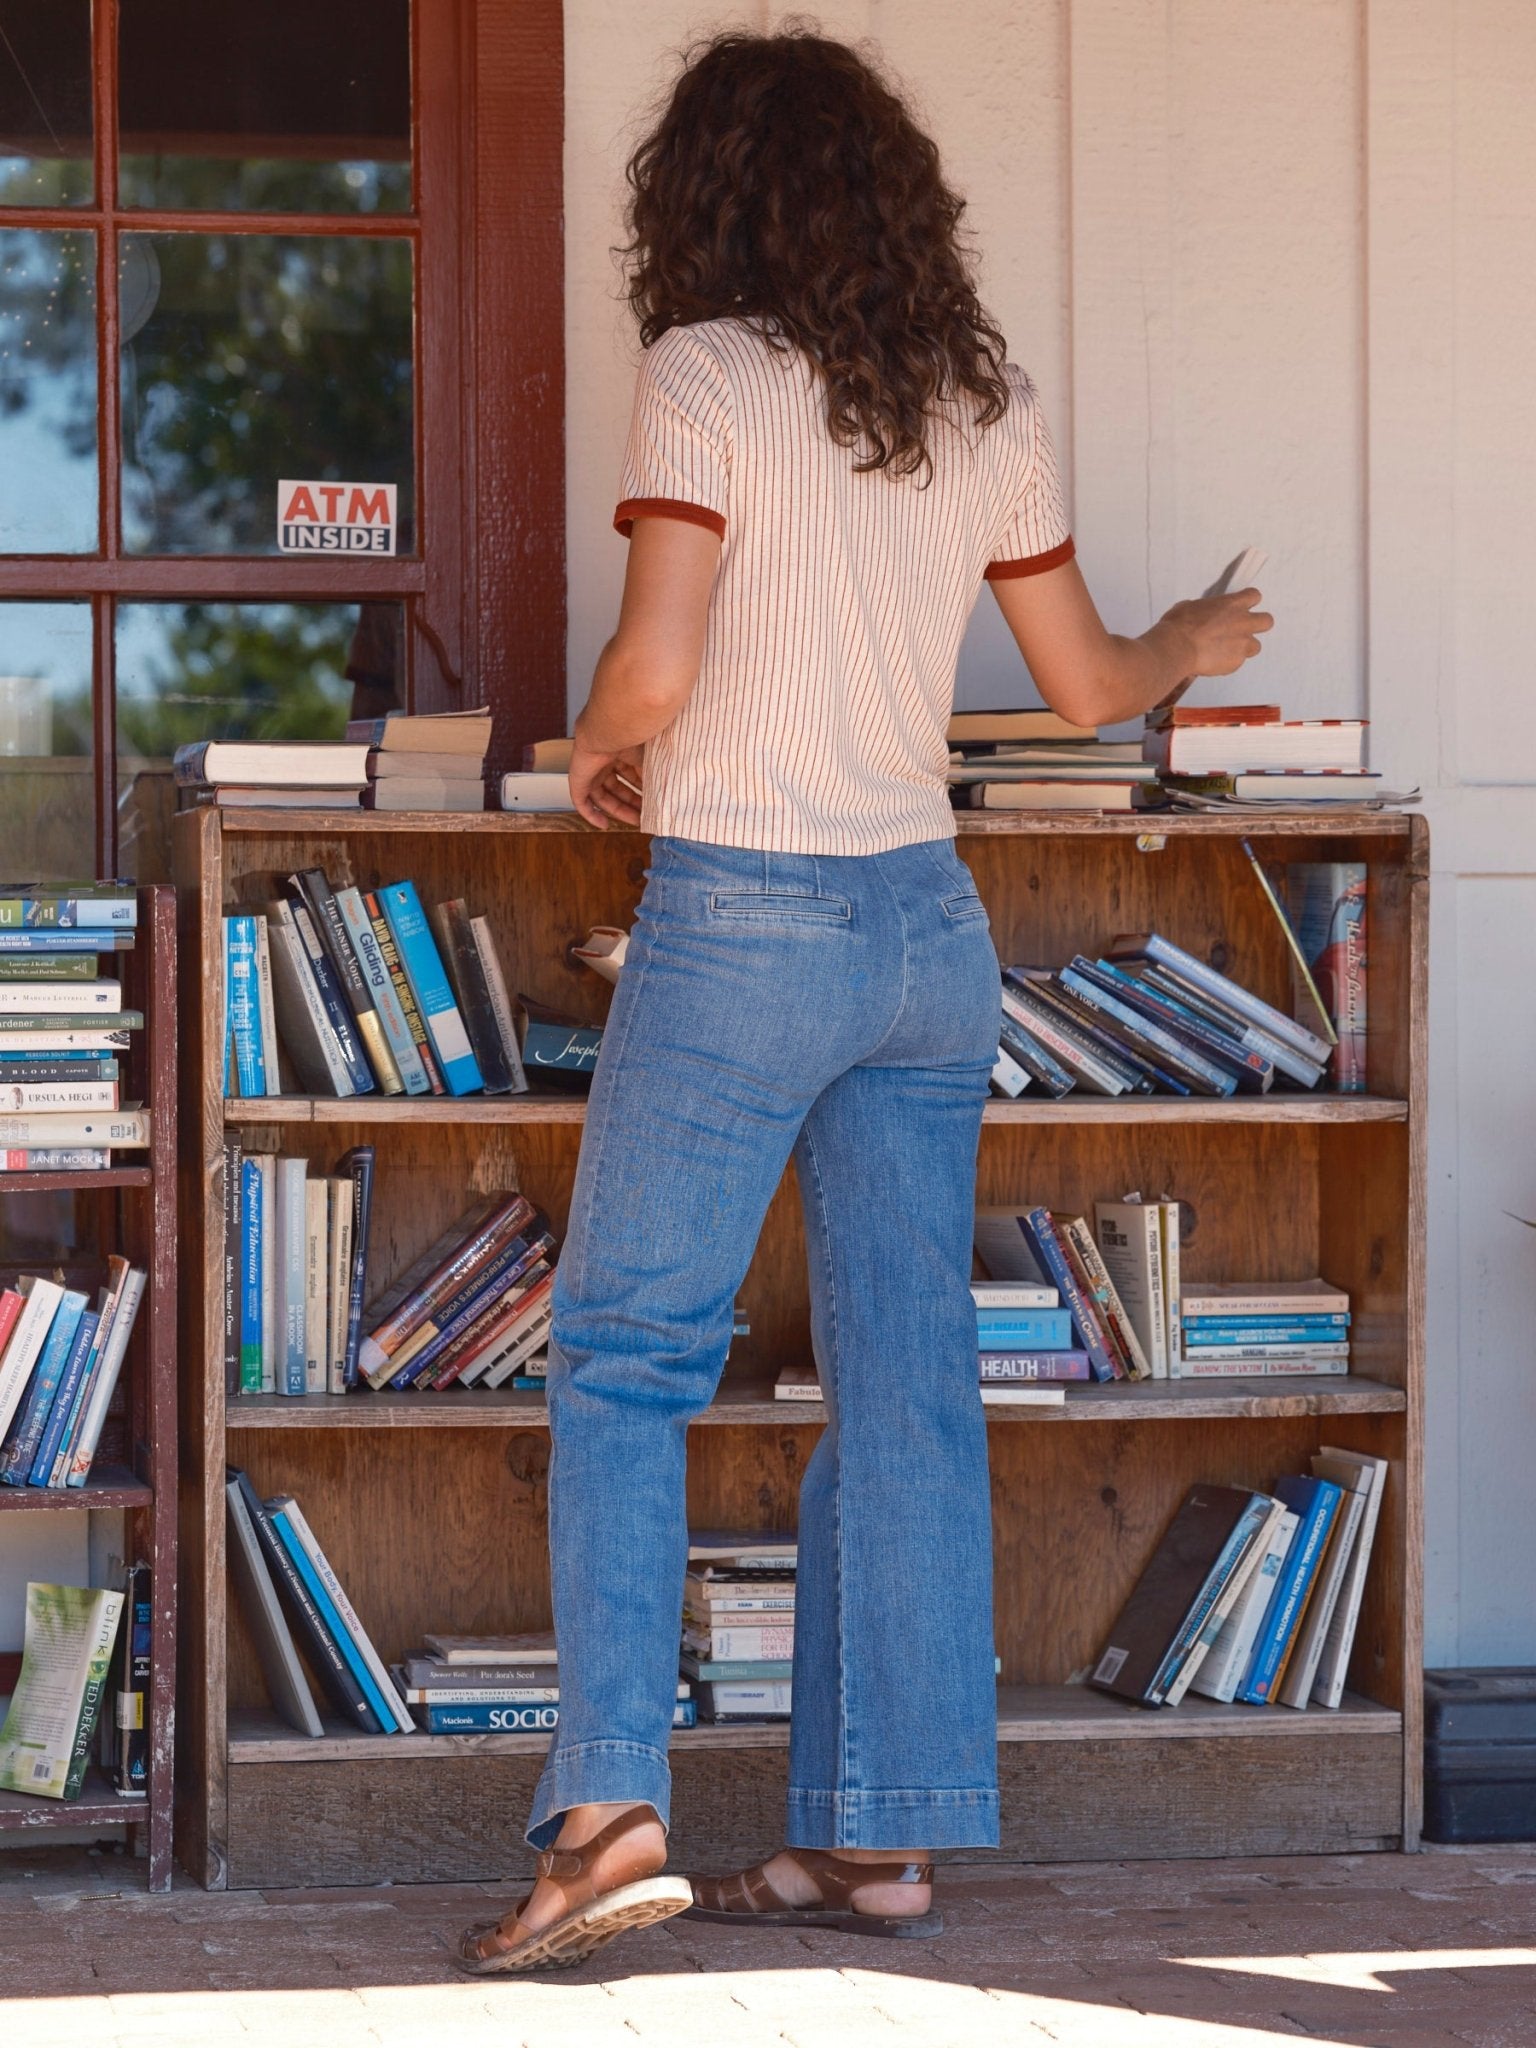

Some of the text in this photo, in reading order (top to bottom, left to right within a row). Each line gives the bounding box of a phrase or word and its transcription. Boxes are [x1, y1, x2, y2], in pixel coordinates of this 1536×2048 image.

[284, 486, 390, 524] ATM
[288, 527, 385, 550] INSIDE
[322, 894, 341, 922] THE
[332, 921, 354, 956] INNER
[345, 955, 366, 990] VOICE
[354, 930, 389, 988] Gliding
[371, 917, 399, 967] DAVID CRAIG
[312, 957, 331, 988] Darker
[390, 970, 406, 985] ON
[483, 966, 505, 1017] American
[394, 982, 416, 1013] SINGING
[1076, 993, 1101, 1013] VOICE
[404, 1010, 427, 1044] ONSTAGE
[1040, 1027, 1083, 1065] DISCIPLINE
[28, 1093, 94, 1102] URSULA HEGI
[31, 1156, 60, 1165] JANET
[63, 1155, 95, 1164] MOCK
[230, 1144, 241, 1179] Principles
[232, 1180, 240, 1193] and
[247, 1172, 259, 1222] Physical
[248, 1226, 259, 1284] Education
[338, 1225, 348, 1286] Grammaire anglaise
[504, 1263, 522, 1280] Care
[457, 1254, 506, 1304] PERFORMER'S
[117, 1289, 139, 1330] CITY
[436, 1298, 460, 1323] VOICE
[463, 1286, 499, 1322] Professional
[1062, 1275, 1100, 1350] THE TITAN'S CURSE
[295, 1303, 303, 1353] CLASSROOM
[448, 1315, 467, 1335] Voice
[994, 1322, 1030, 1331] DISEASE
[7, 1331, 34, 1385] HEALTHY SLEEP
[55, 1327, 92, 1420] Children Learn What They Live
[981, 1360, 1039, 1377] HEALTH
[1223, 1363, 1236, 1373] THE
[1237, 1362, 1263, 1372] VICTIM
[1278, 1361, 1301, 1372] William
[21, 1397, 46, 1454] THE WEEPING TIDE
[259, 1516, 278, 1545] Pictorial
[272, 1543, 290, 1570] History
[290, 1575, 308, 1603] Norman
[303, 1601, 314, 1615] and
[310, 1613, 331, 1646] Cleveland
[326, 1644, 344, 1671] County
[312, 1551, 361, 1632] Your Body, Your Voice
[1274, 1507, 1328, 1642] OCCUPATIONAL HEALTH PROMOTION
[96, 1603, 116, 1655] blink
[1180, 1600, 1212, 1648] EVALUATION
[761, 1644, 775, 1652] FOR
[516, 1671, 535, 1679] Seed
[73, 1678, 101, 1758] TED DEKKER
[442, 1709, 559, 1728] Macionis SOCIO
